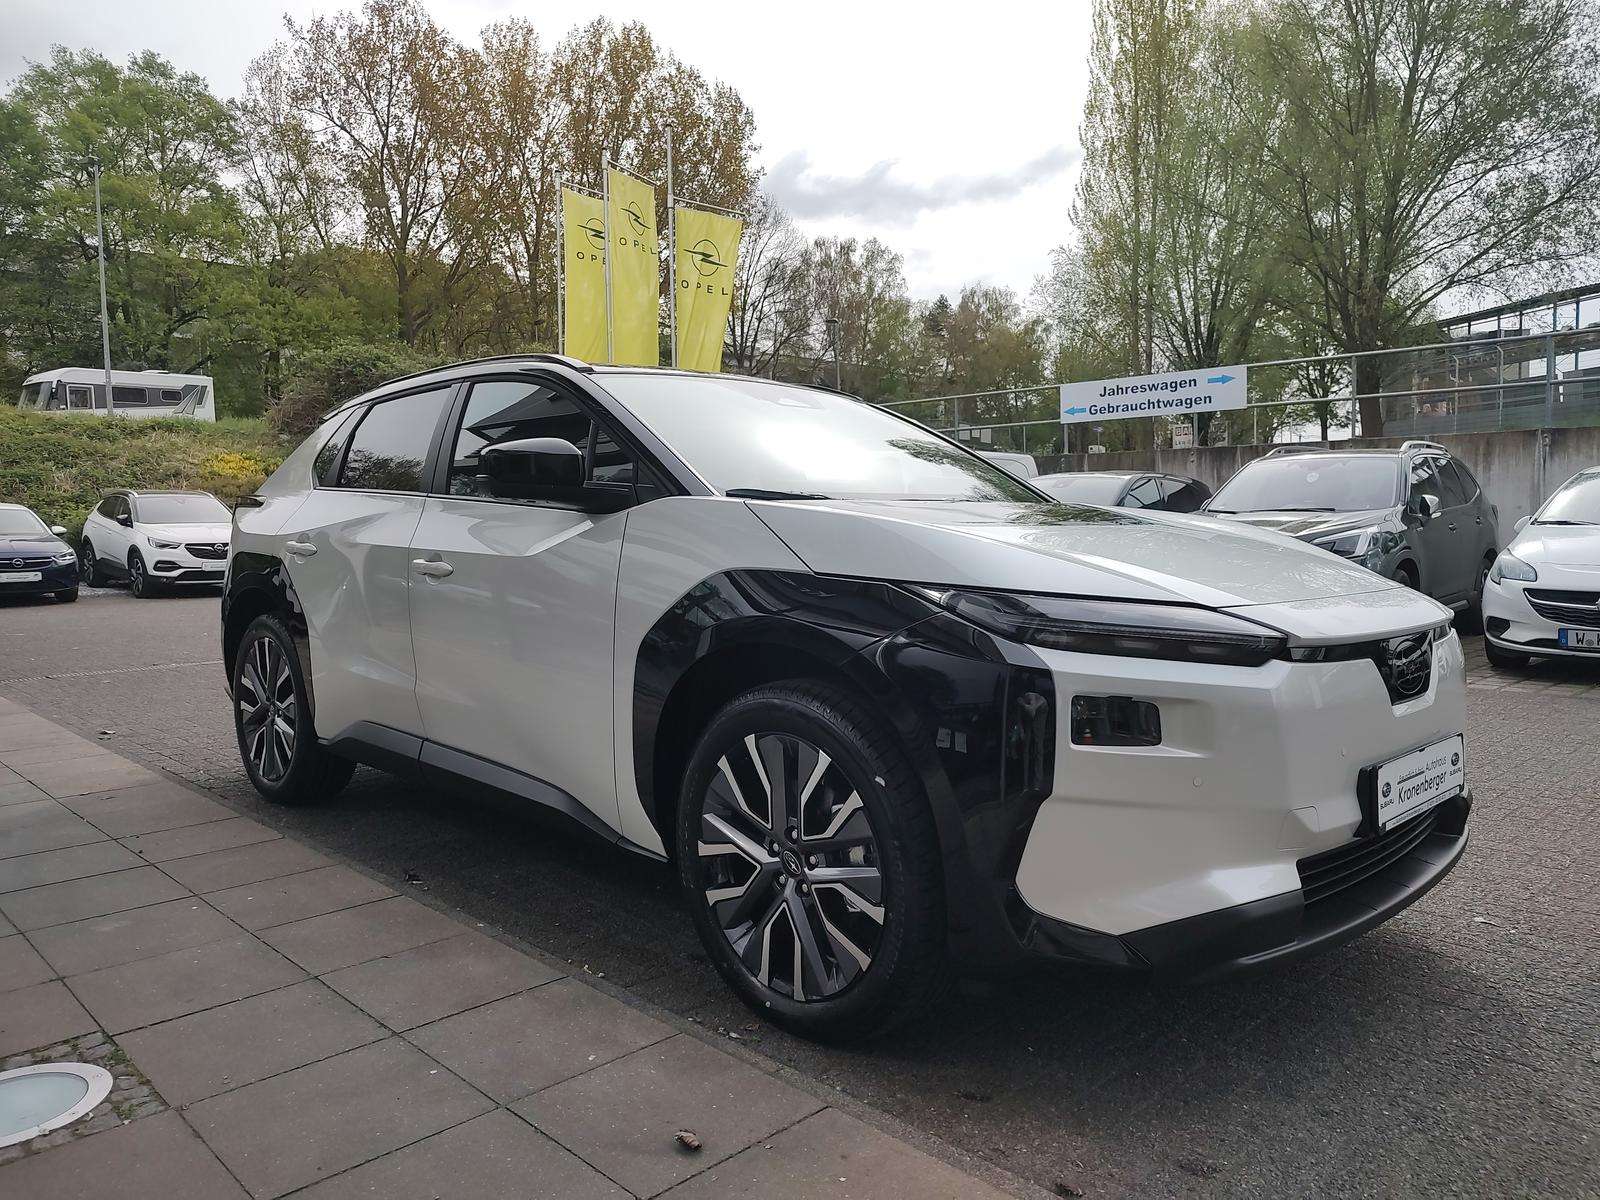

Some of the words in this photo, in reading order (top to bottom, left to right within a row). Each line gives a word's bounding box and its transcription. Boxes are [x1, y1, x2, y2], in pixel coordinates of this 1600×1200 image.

[619, 237, 657, 255] OPEL
[681, 279, 728, 296] OPEL
[1099, 377, 1197, 397] Jahreswagen
[1088, 395, 1212, 416] Gebrauchtwagen
[1425, 754, 1447, 772] Autohaus
[1397, 771, 1447, 804] Kronenberger
